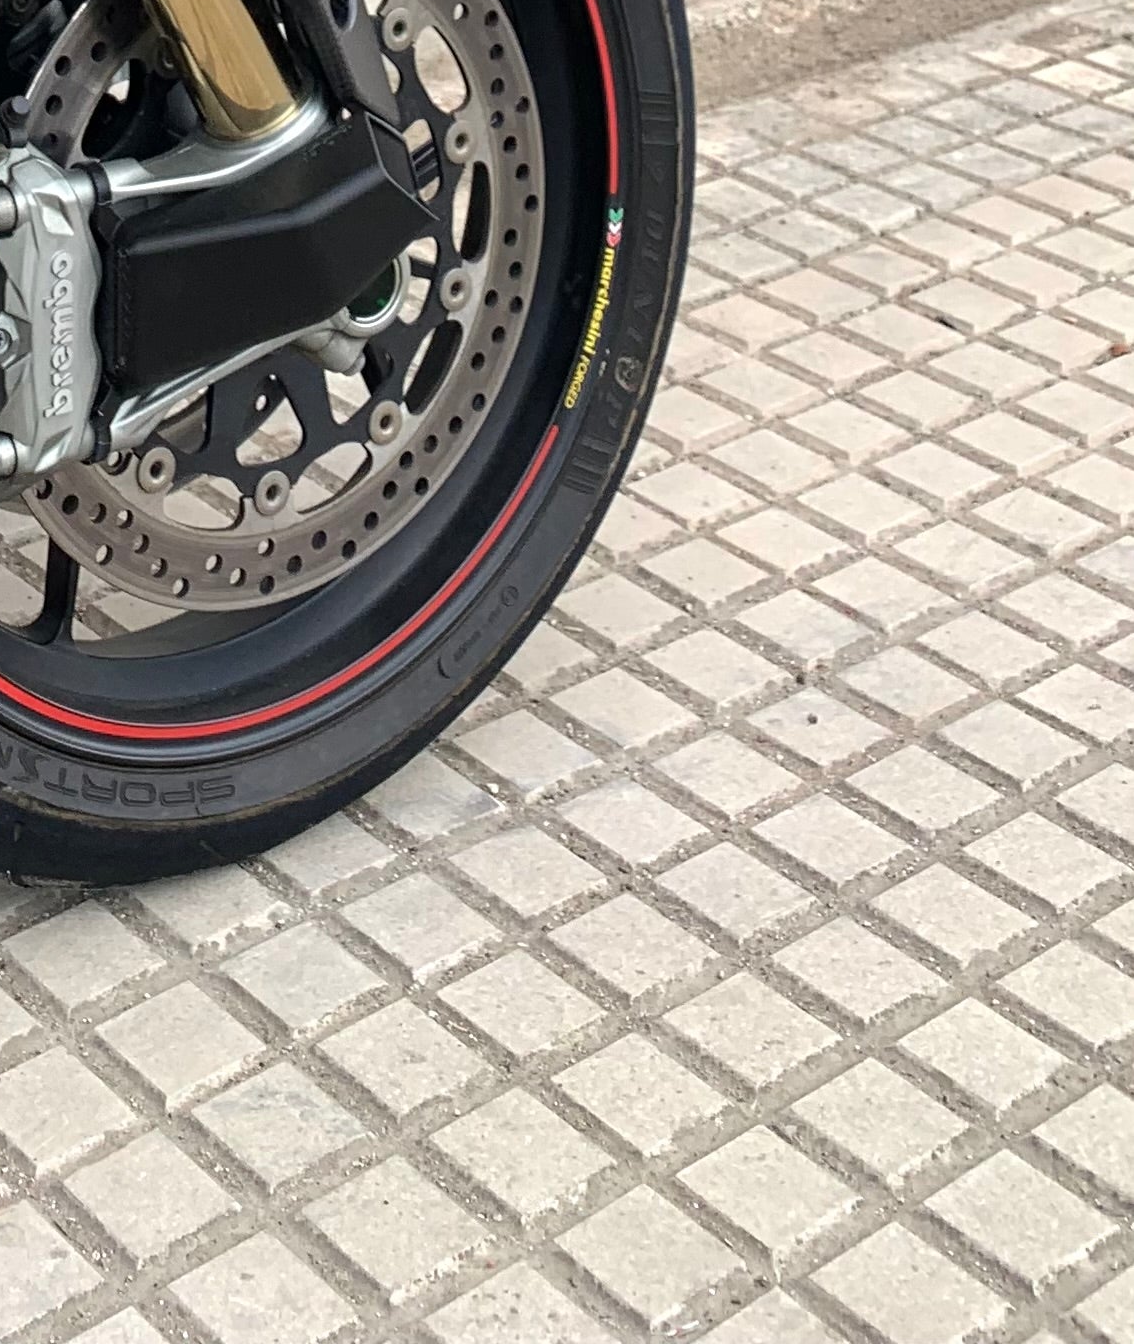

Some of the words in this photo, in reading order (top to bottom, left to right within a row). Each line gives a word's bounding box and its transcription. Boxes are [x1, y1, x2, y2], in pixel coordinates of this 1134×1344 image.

[42, 249, 73, 419] brembo
[582, 247, 616, 355] marchesini
[564, 353, 592, 410] FORGED
